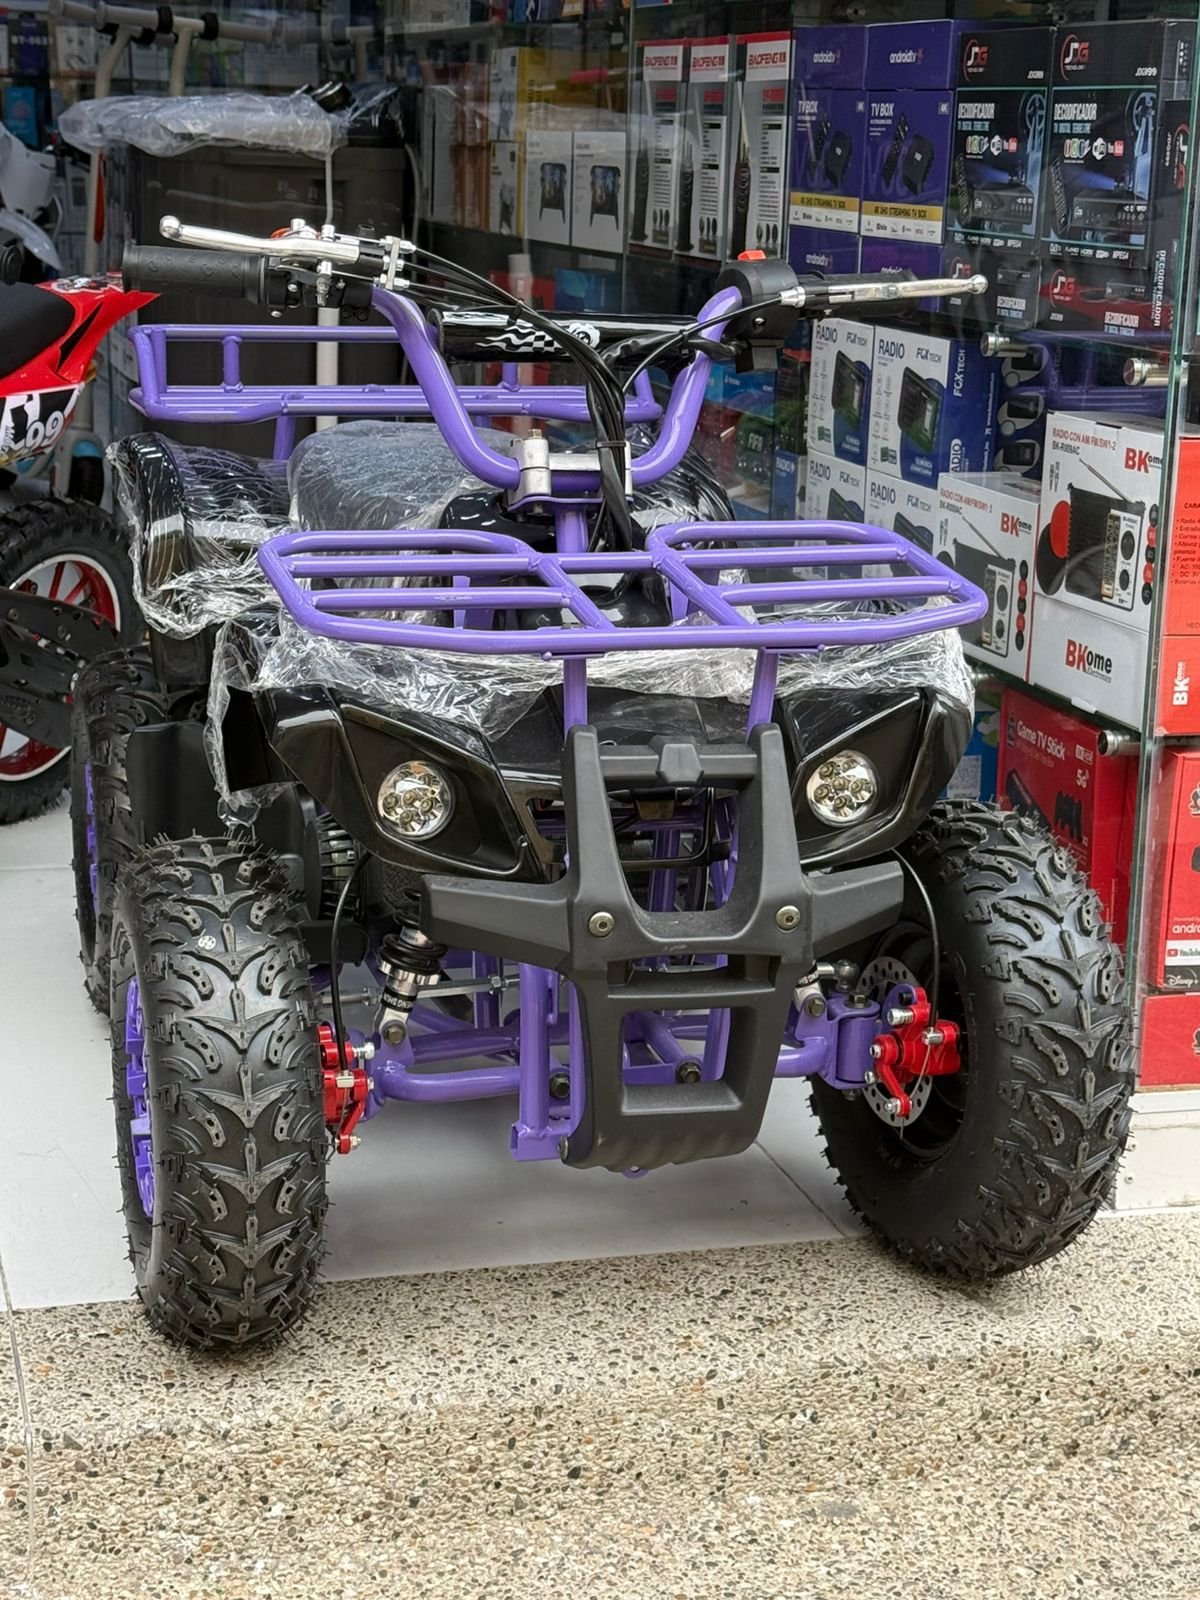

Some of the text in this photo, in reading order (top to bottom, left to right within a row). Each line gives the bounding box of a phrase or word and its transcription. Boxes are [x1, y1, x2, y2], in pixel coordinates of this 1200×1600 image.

[645, 56, 671, 66] BAOFENG
[692, 56, 717, 68] BAOFENG
[749, 53, 777, 65] BAOFENG
[798, 101, 818, 113] TV BOX
[871, 103, 894, 117] TV BOX
[1054, 103, 1097, 120] DECODIFICADOR
[1153, 250, 1166, 327] DECODIFICADOR
[816, 325, 838, 343] RADIO
[879, 339, 905, 359] RADIO
[1053, 428, 1069, 440] RADIO
[1069, 431, 1081, 442] CON
[951, 442, 962, 473] ADIO
[810, 460, 831, 481] RADIO
[871, 482, 896, 504] RADIO
[1065, 639, 1112, 674] BKome
[1173, 661, 1189, 706] BKome
[1017, 720, 1037, 745] Game
[1037, 731, 1048, 751] TV
[1047, 736, 1066, 761] Stick
